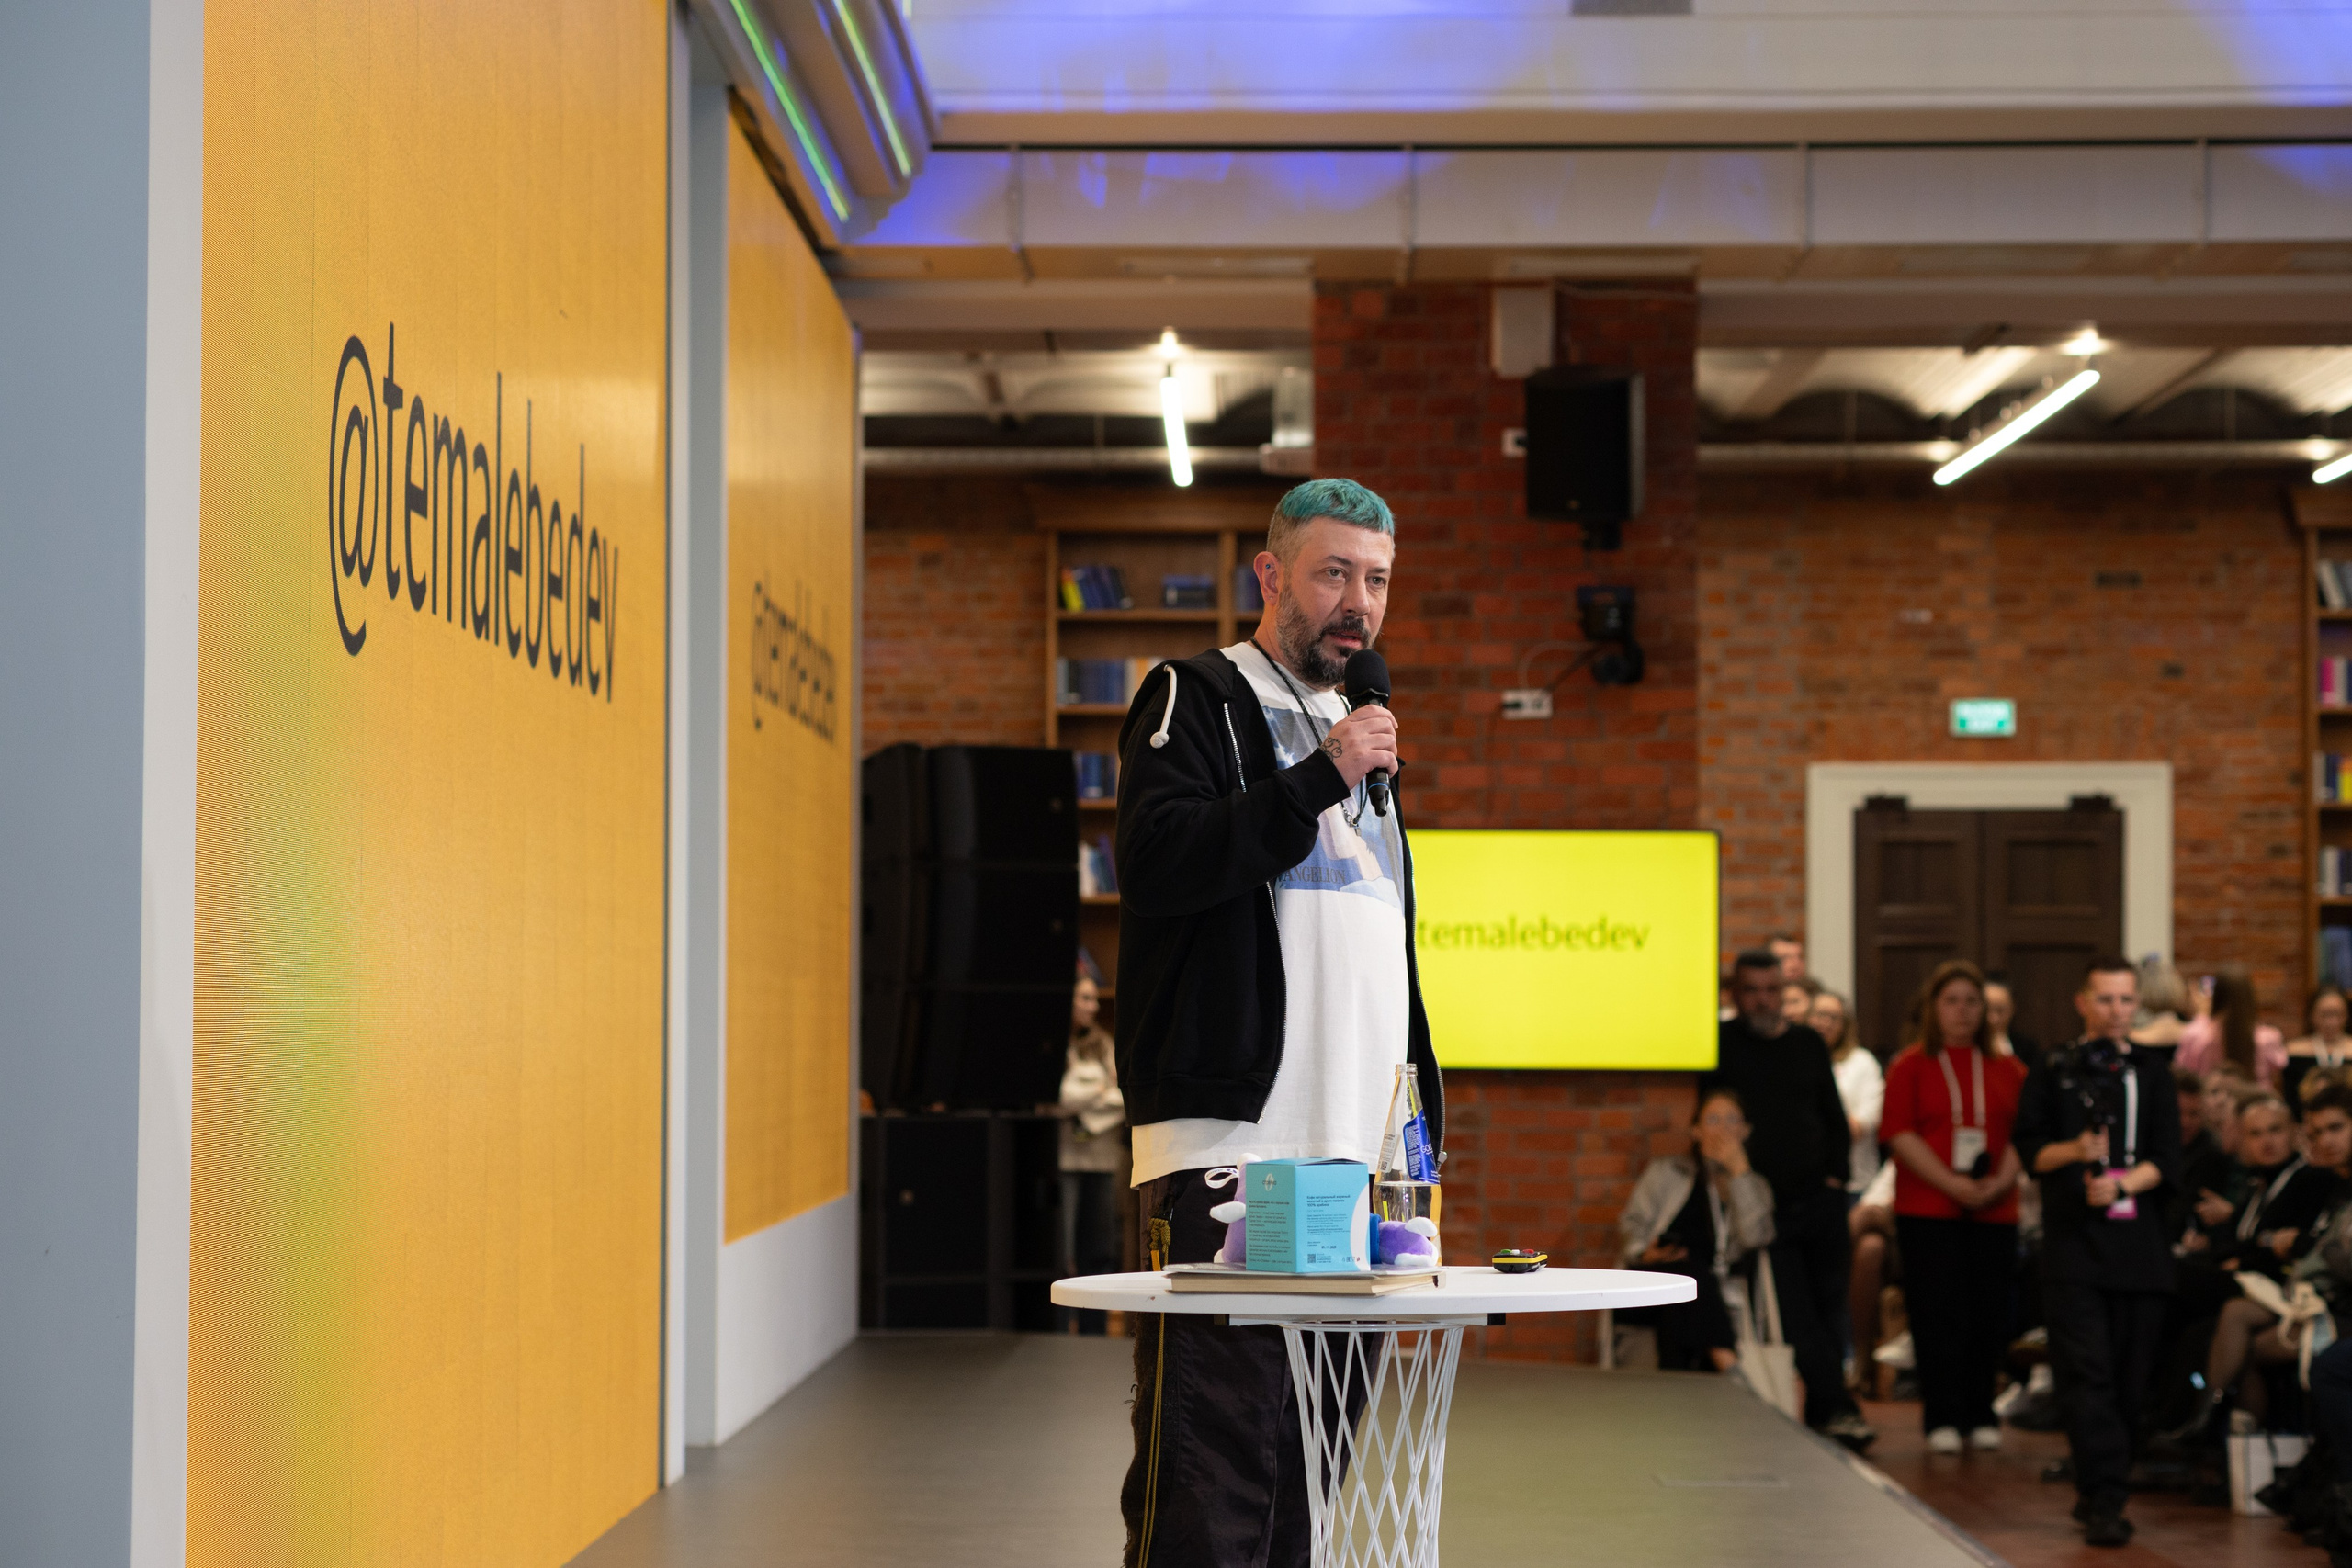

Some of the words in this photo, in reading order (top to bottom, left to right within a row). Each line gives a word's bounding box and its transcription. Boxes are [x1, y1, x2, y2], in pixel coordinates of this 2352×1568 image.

[329, 321, 617, 704] @temalebedev
[1278, 866, 1346, 884] ANGELION
[1418, 915, 1651, 951] temalebedev
